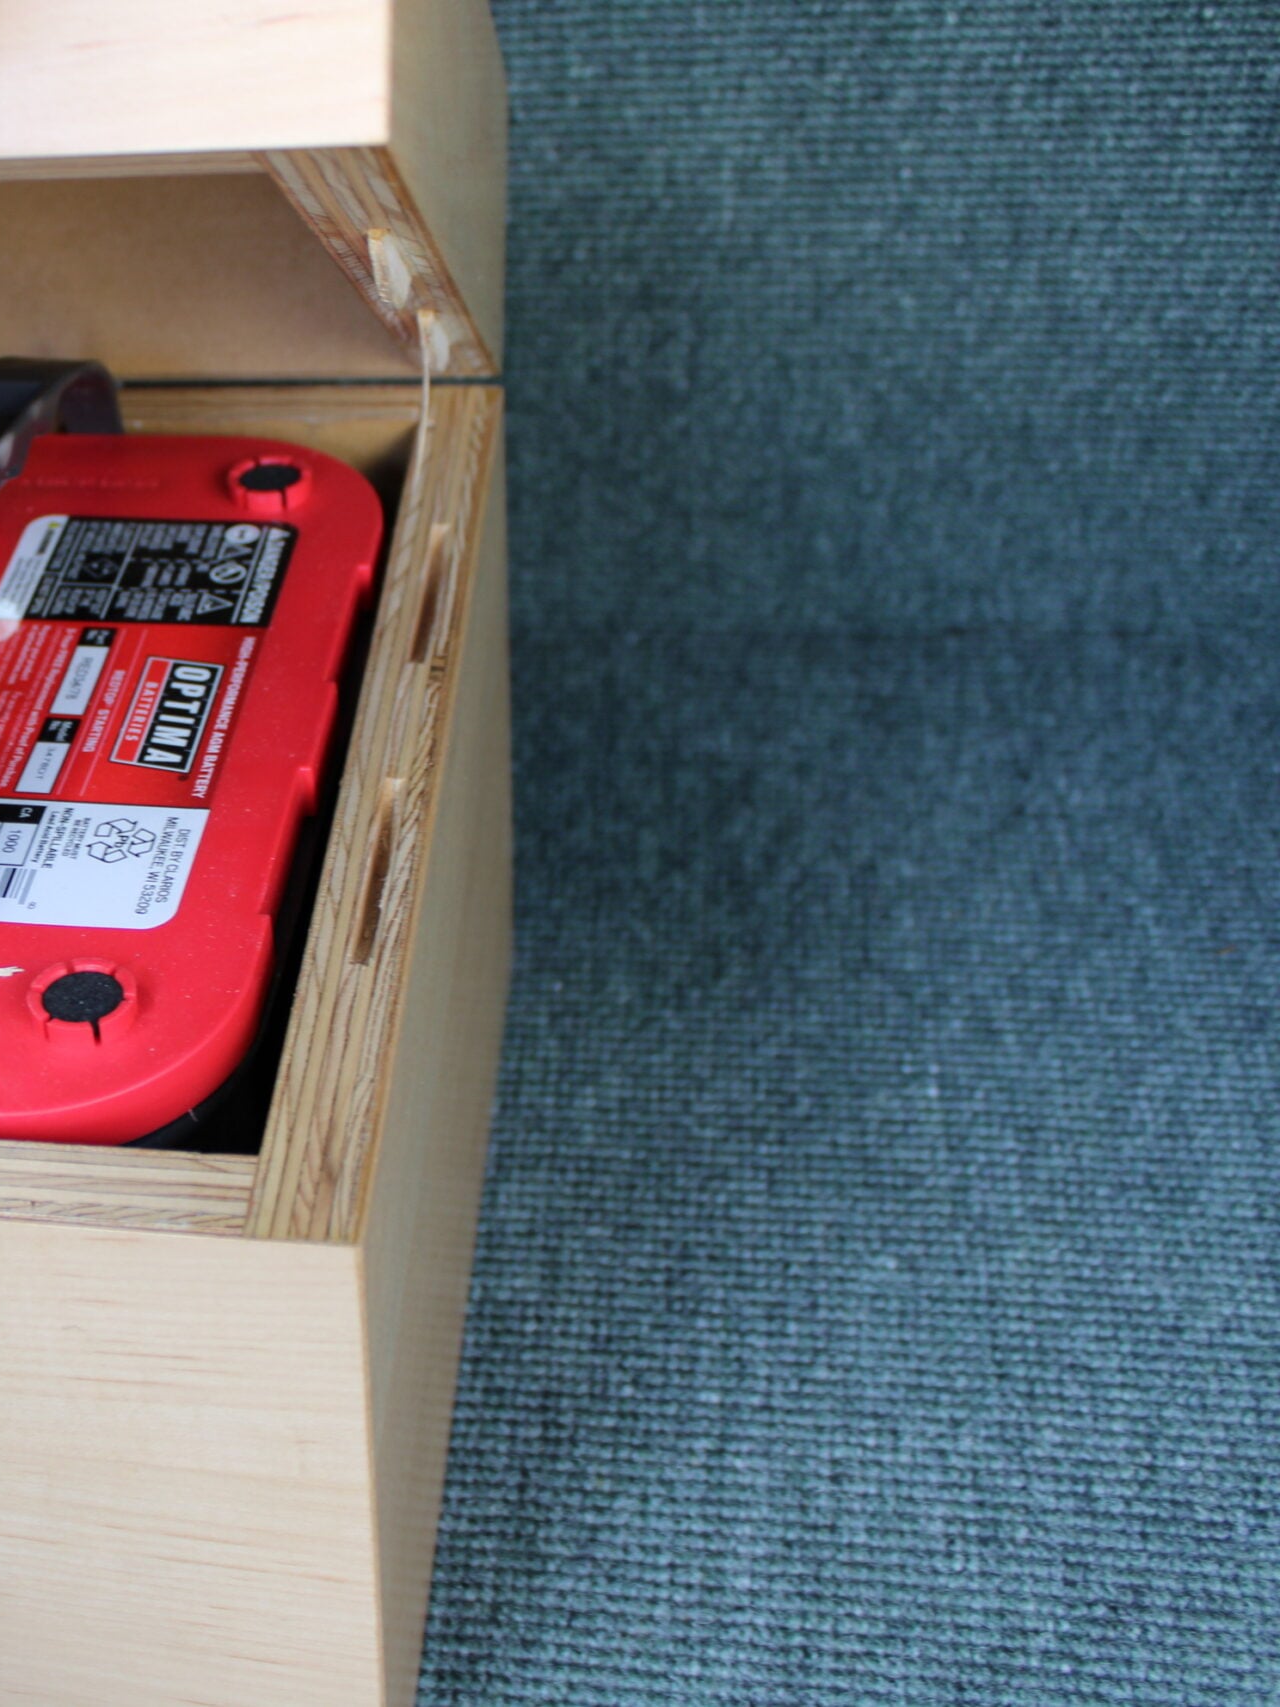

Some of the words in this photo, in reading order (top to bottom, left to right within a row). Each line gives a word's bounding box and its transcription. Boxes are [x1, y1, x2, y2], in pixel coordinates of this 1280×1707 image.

[215, 637, 253, 728] HIGH-PERFORMANCE
[27, 710, 38, 726] with
[125, 682, 157, 740] BATTERIES
[145, 666, 209, 761] OPTIMA
[19, 726, 34, 746] Proof
[83, 709, 108, 751] STARTING
[15, 746, 24, 755] of
[207, 732, 224, 752] AGM
[193, 754, 216, 797] BATTERY
[19, 807, 32, 817] CA
[47, 811, 57, 824] Lead
[2, 830, 21, 852] 1000
[42, 825, 52, 838] Acid
[42, 807, 73, 867] NON-SPILLABLE
[114, 834, 129, 847] Pb
[152, 816, 178, 864] MILWAUKEE,
[174, 828, 190, 847] DIST.
[31, 839, 47, 862] Battery
[169, 850, 183, 862] BY
[146, 871, 159, 882] WI
[155, 864, 177, 902] CLARIOS
[135, 884, 155, 914] 53209
